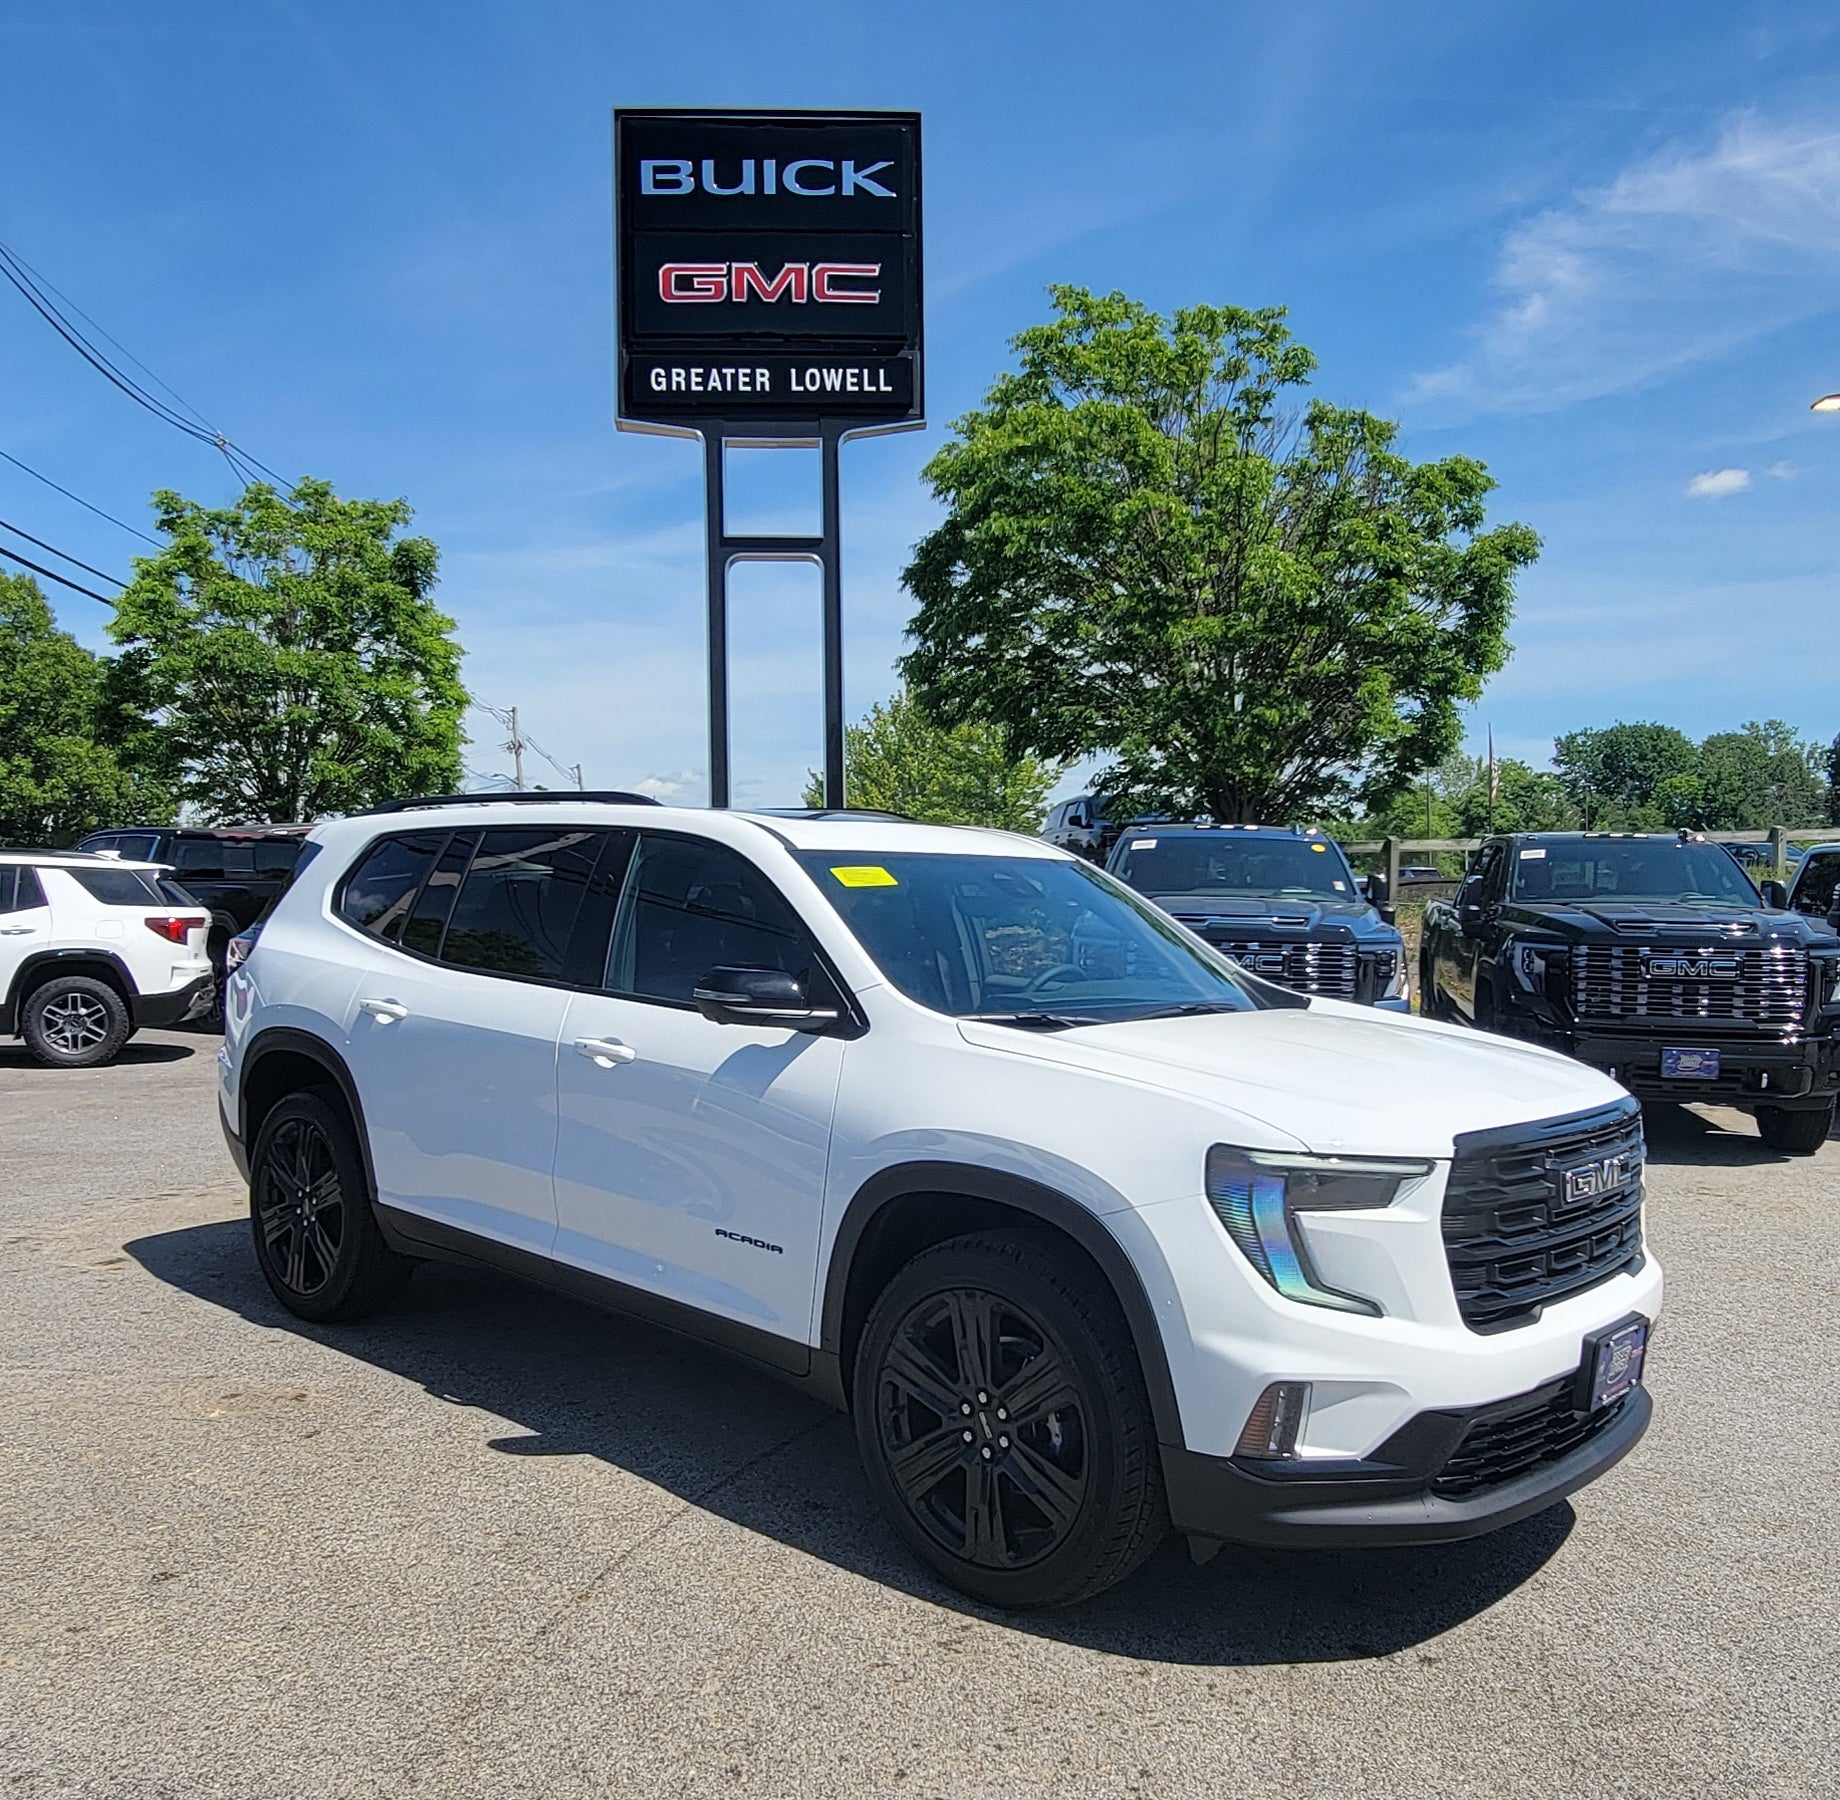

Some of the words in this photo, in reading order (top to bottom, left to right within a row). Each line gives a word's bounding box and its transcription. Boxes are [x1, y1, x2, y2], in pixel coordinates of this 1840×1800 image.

[640, 159, 897, 197] BUICK
[658, 262, 882, 304] GMC
[650, 368, 770, 392] GREATER
[791, 368, 893, 392] LOWELL
[1226, 954, 1283, 972] MC
[1649, 959, 1738, 977] GMC
[1566, 1152, 1631, 1202] GMC
[715, 1228, 783, 1255] ACADIA
